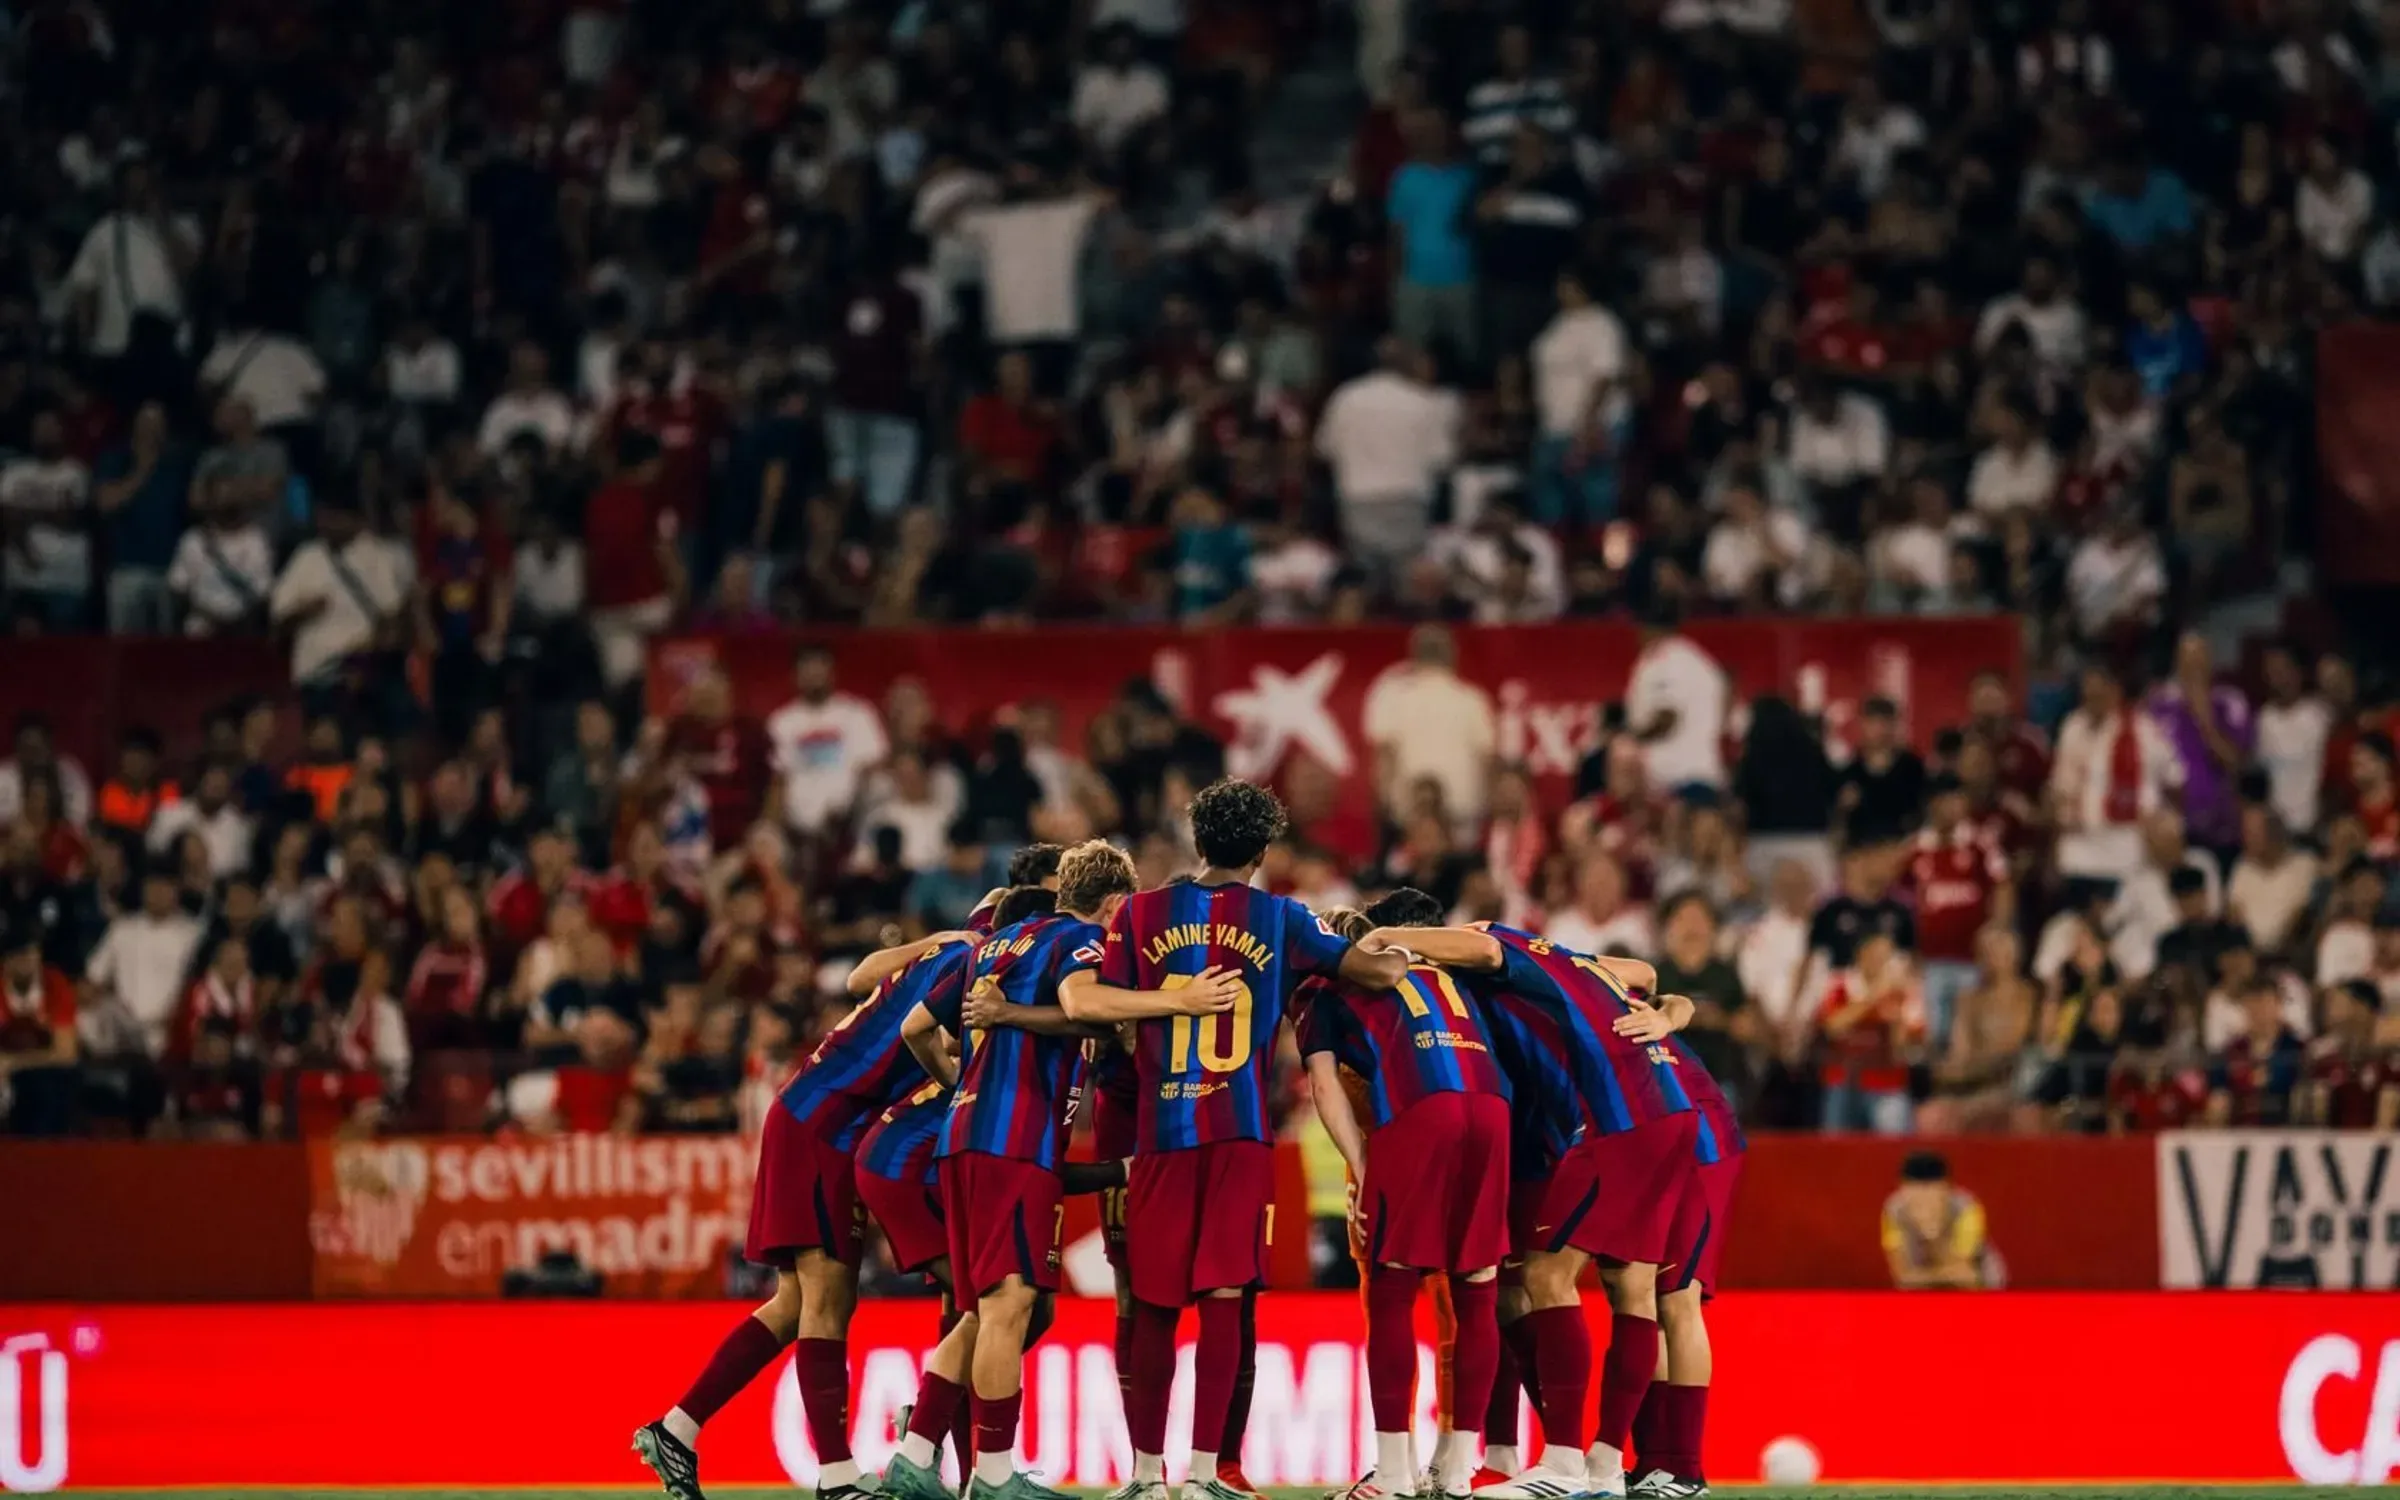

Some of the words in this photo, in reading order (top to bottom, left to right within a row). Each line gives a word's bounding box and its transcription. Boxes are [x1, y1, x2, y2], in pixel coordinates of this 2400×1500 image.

[1142, 923, 1211, 965] LAMINE
[1215, 923, 1275, 972] YAMAL
[1159, 973, 1253, 1074] 10
[2176, 1145, 2400, 1289] VAY
